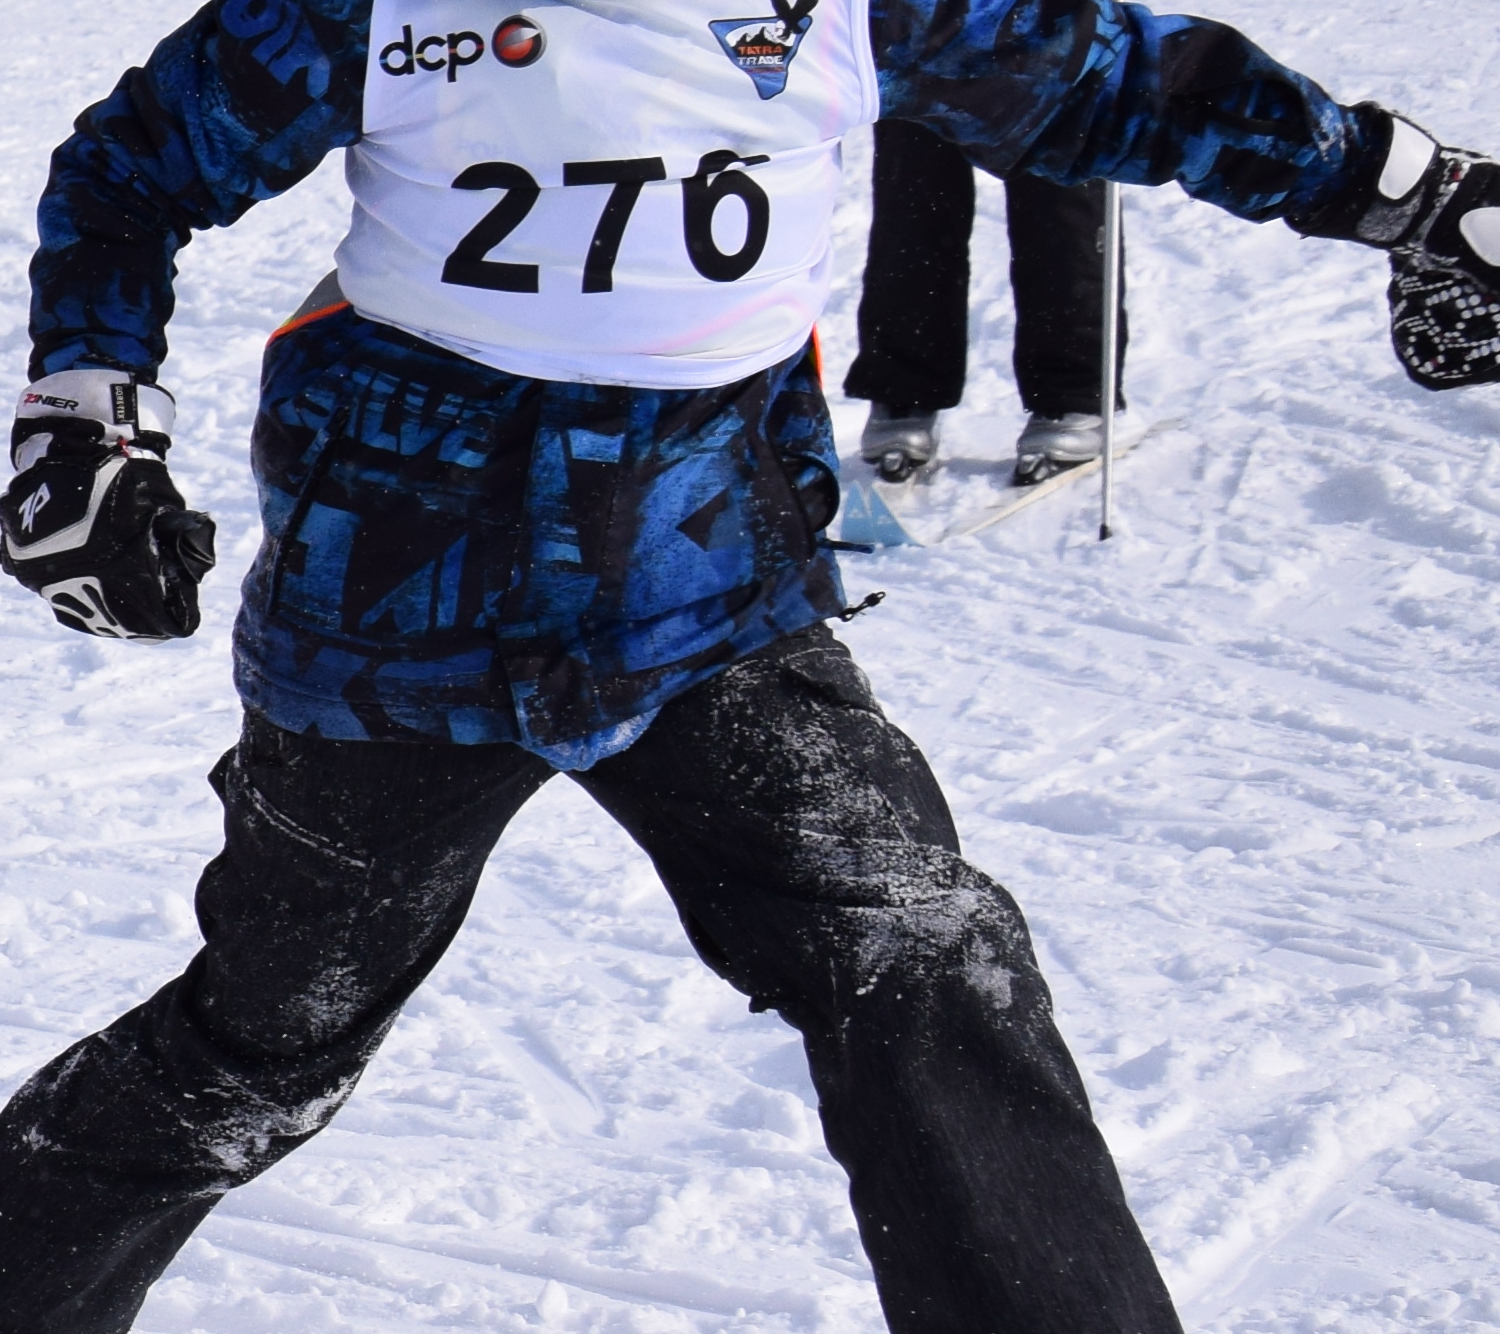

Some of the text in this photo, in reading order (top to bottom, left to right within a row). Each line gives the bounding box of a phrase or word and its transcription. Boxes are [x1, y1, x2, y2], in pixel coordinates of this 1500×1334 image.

[379, 24, 485, 83] dcp
[737, 55, 783, 66] TRADE
[738, 45, 783, 55] TATRA
[441, 149, 771, 295] 276
